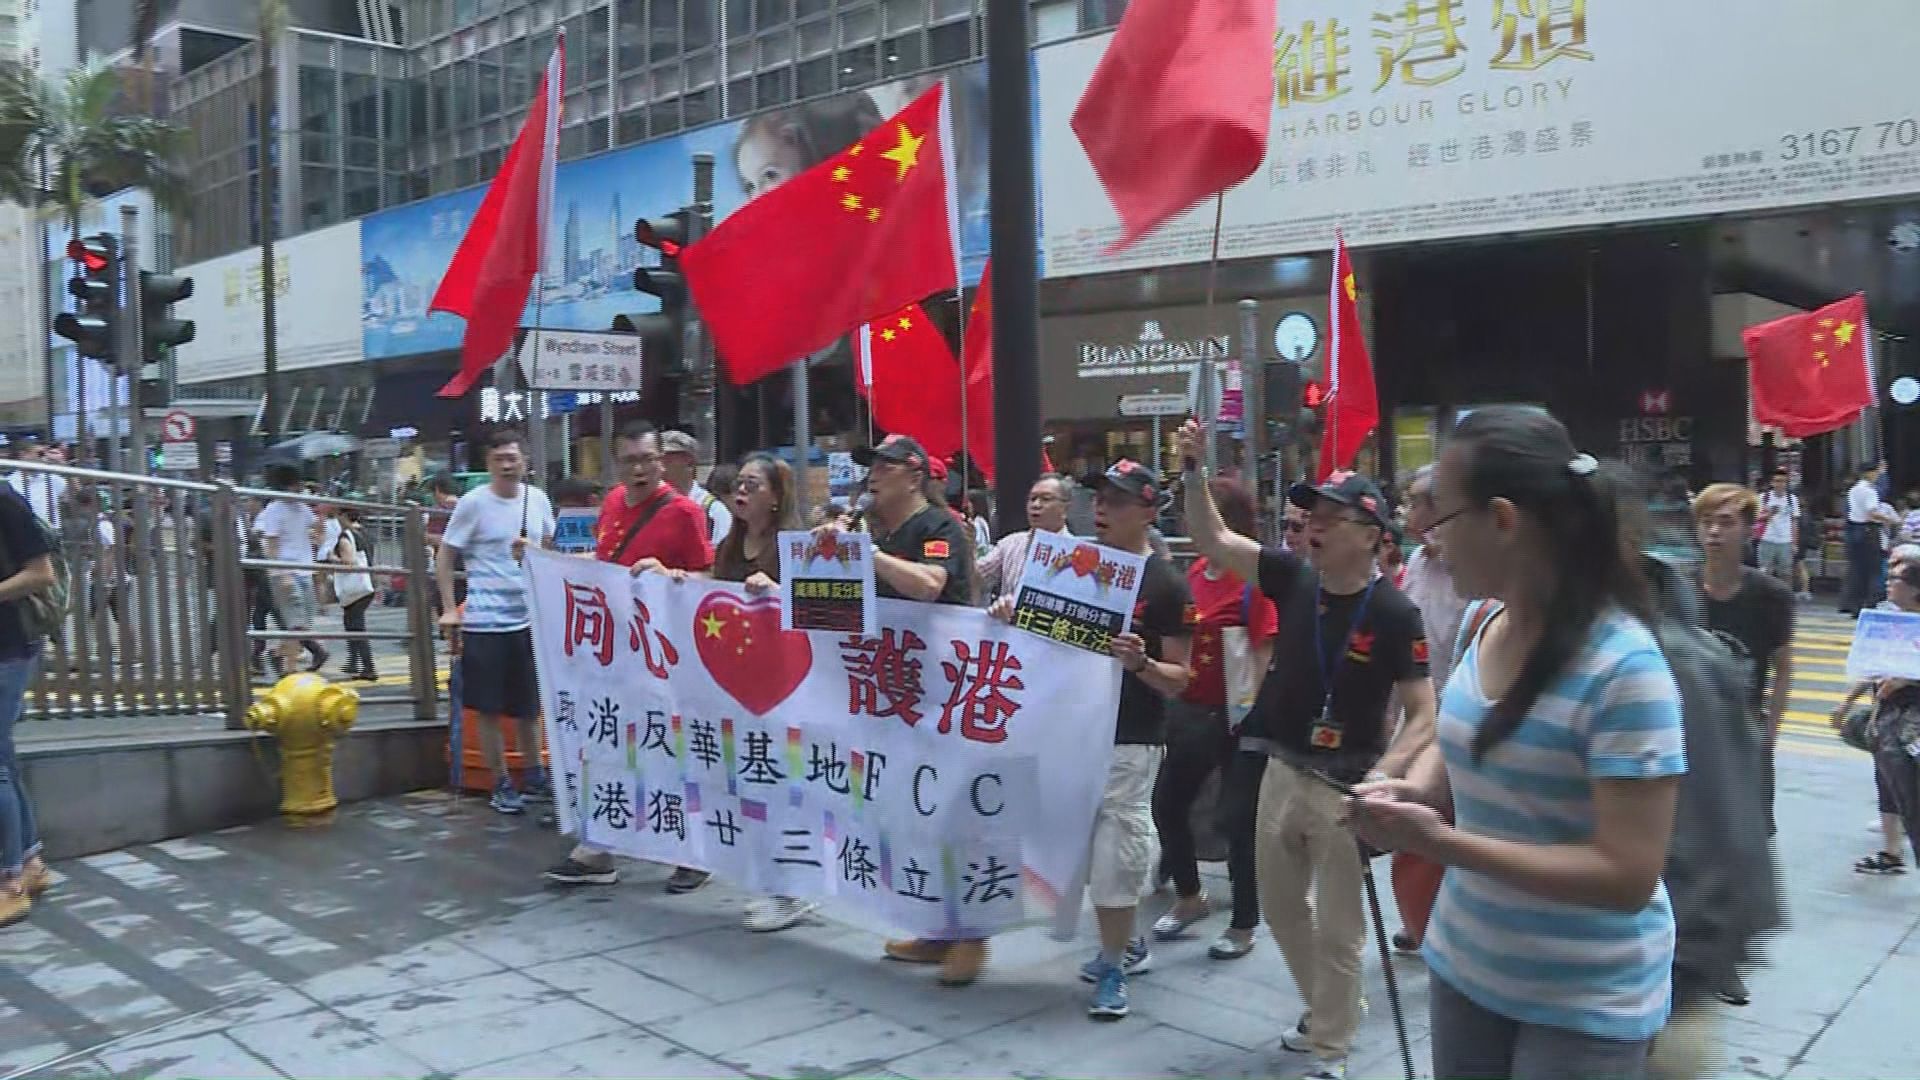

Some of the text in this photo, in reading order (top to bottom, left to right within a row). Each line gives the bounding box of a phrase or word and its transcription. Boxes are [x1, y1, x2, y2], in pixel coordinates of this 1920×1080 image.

[1280, 77, 1574, 141] HARBOUR GLORY
[1407, 119, 1594, 169] 經世港灣盛景
[1779, 125, 1862, 162] 3167
[1872, 118, 1920, 150] 70
[544, 337, 637, 356] Wyndham Street
[1078, 335, 1230, 367] BLANCPAIN
[1617, 417, 1694, 442] HSBC
[1015, 606, 1113, 652] 廿三條立法
[563, 577, 1026, 744] 同心 護港
